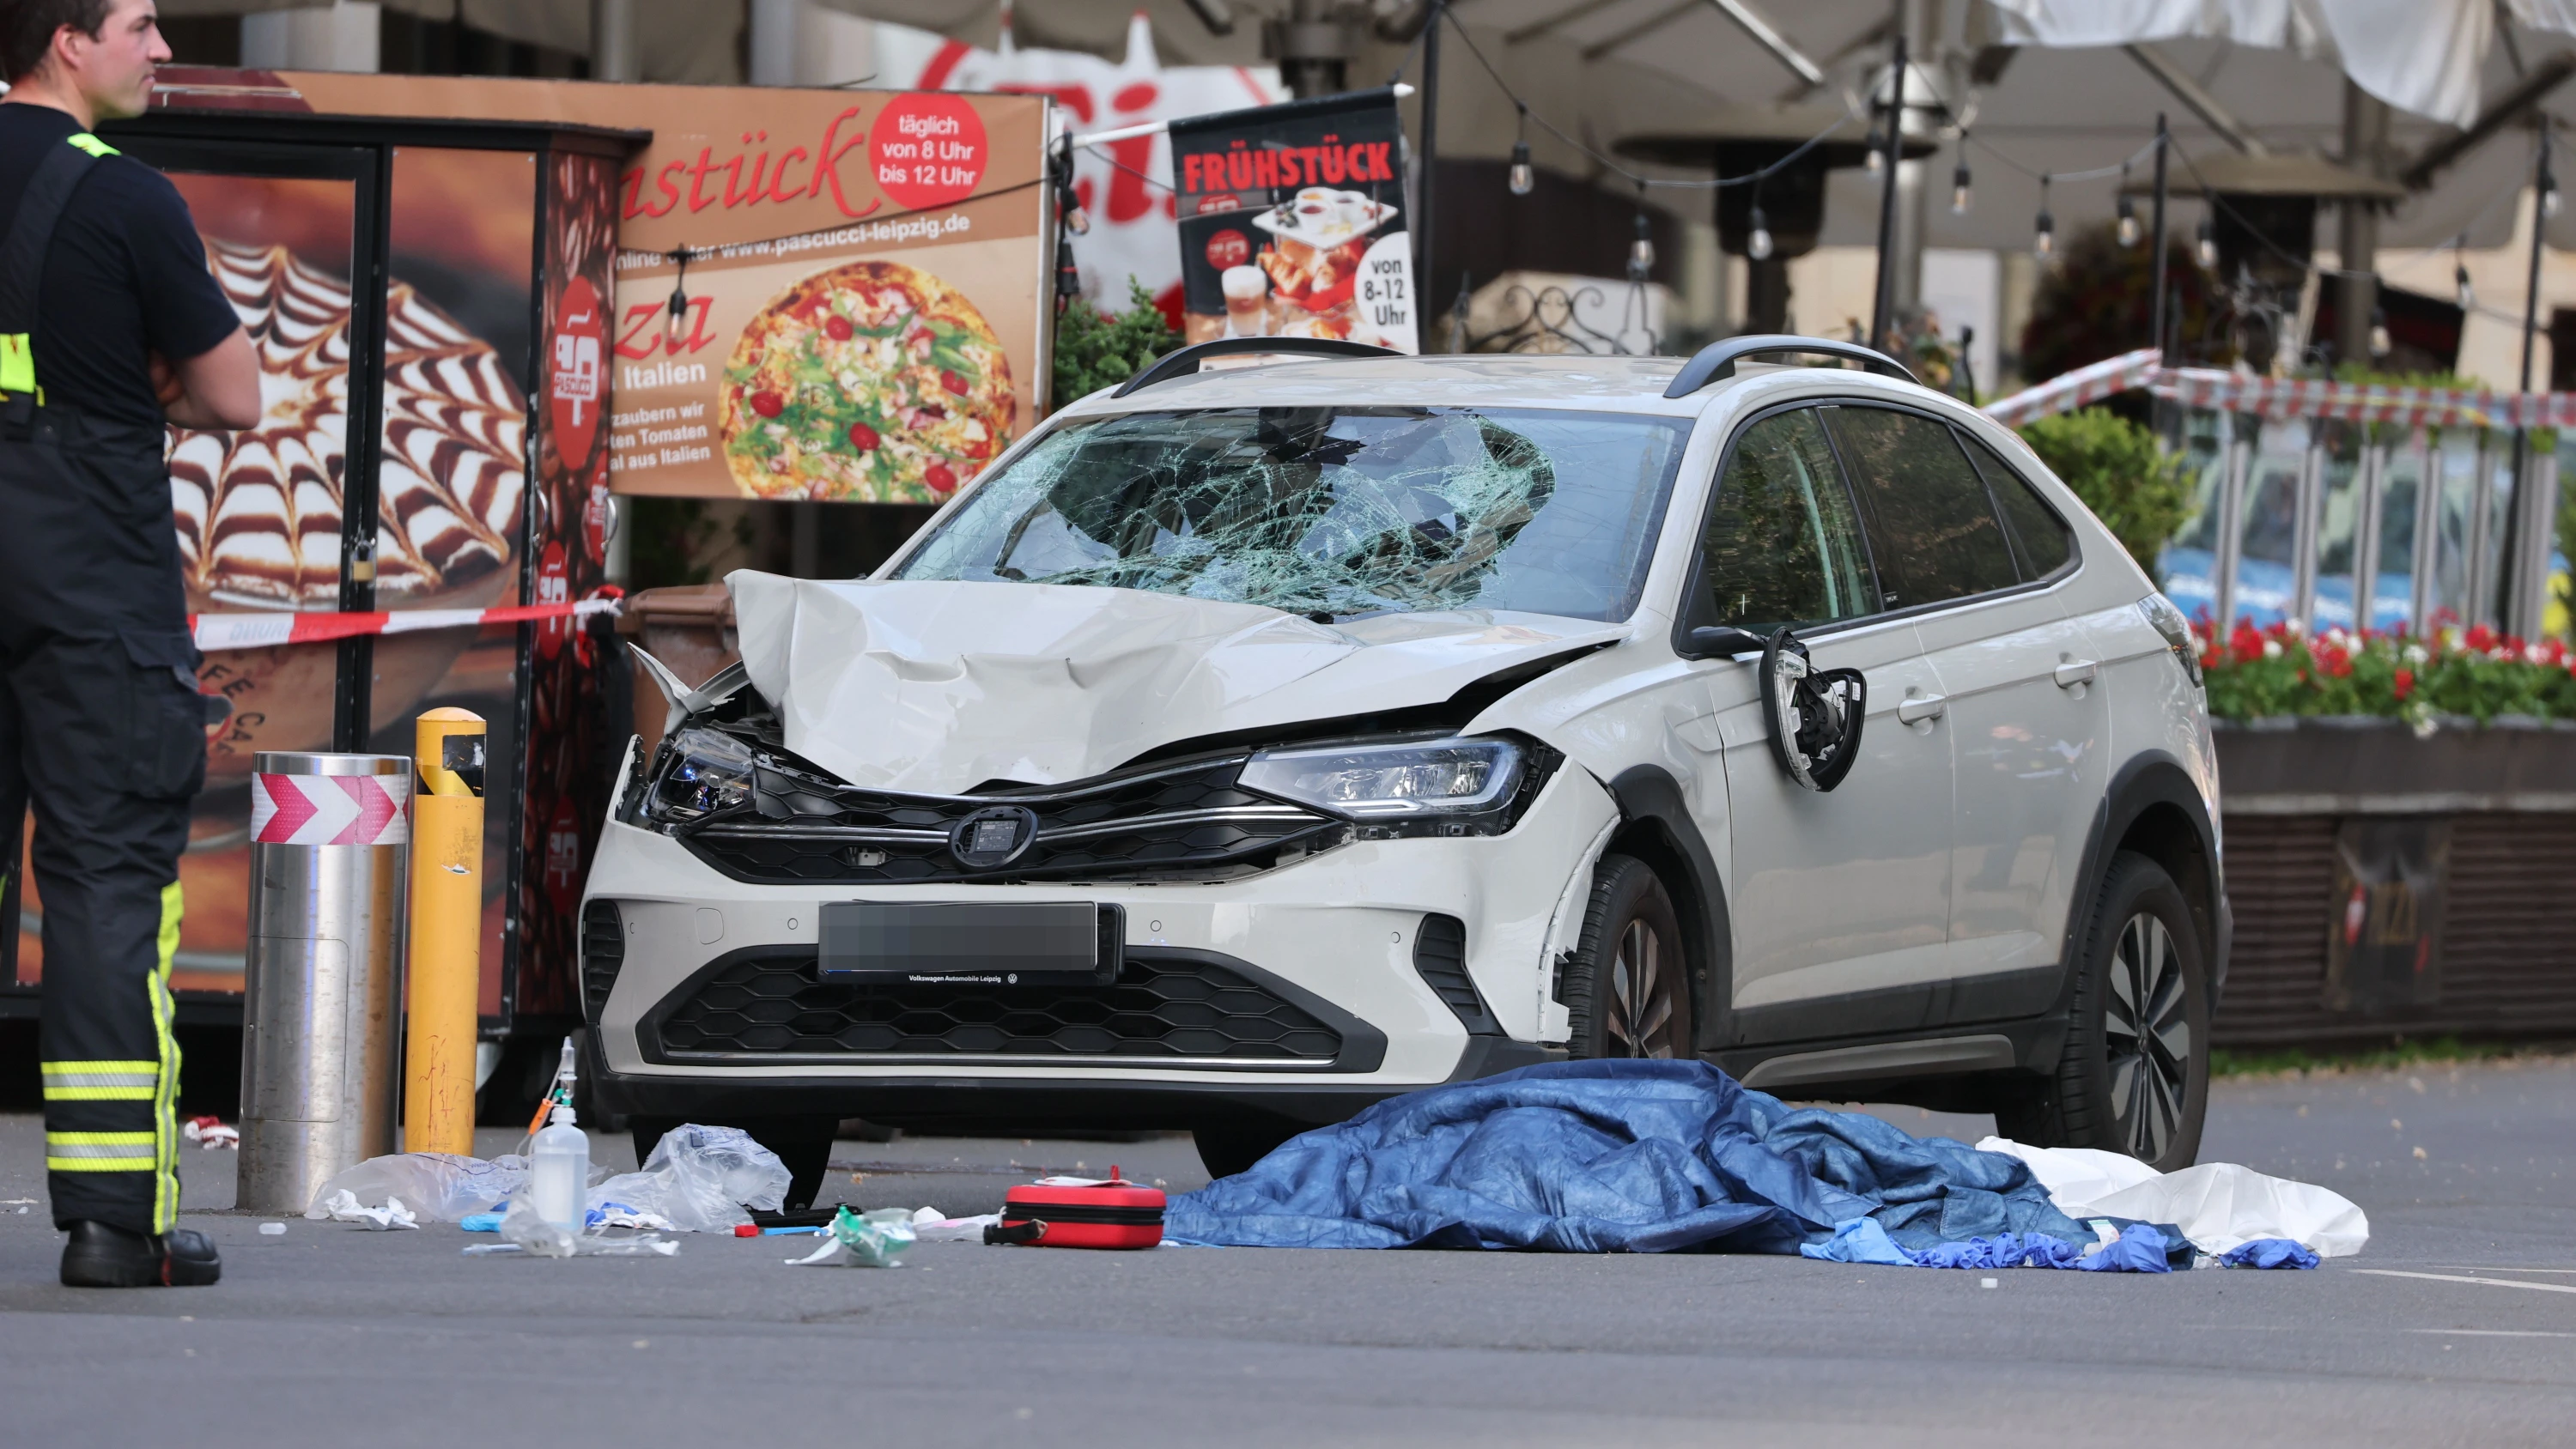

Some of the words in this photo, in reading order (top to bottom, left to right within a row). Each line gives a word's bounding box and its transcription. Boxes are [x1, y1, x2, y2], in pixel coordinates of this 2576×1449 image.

[899, 114, 959, 138] täglich
[882, 142, 917, 159] von
[921, 140, 934, 160] 8
[939, 141, 975, 161] Uhr
[1183, 134, 1394, 193] FRÜHSTÜCK
[879, 164, 907, 185] bis
[913, 165, 936, 185] 12
[940, 166, 976, 186] Uhr
[720, 213, 970, 258] www.pascucci-leipzig.de
[1370, 258, 1402, 275] von
[1364, 279, 1405, 300] 8-12
[1375, 305, 1406, 326] Uhr
[624, 361, 706, 390] Italien
[611, 408, 677, 427] zaubern
[679, 400, 704, 419] wir
[638, 424, 708, 446] Tomaten
[628, 452, 657, 470] aus
[660, 445, 710, 465] Italien
[908, 974, 945, 983] Volkswagen
[980, 975, 1001, 984] Leipzig
